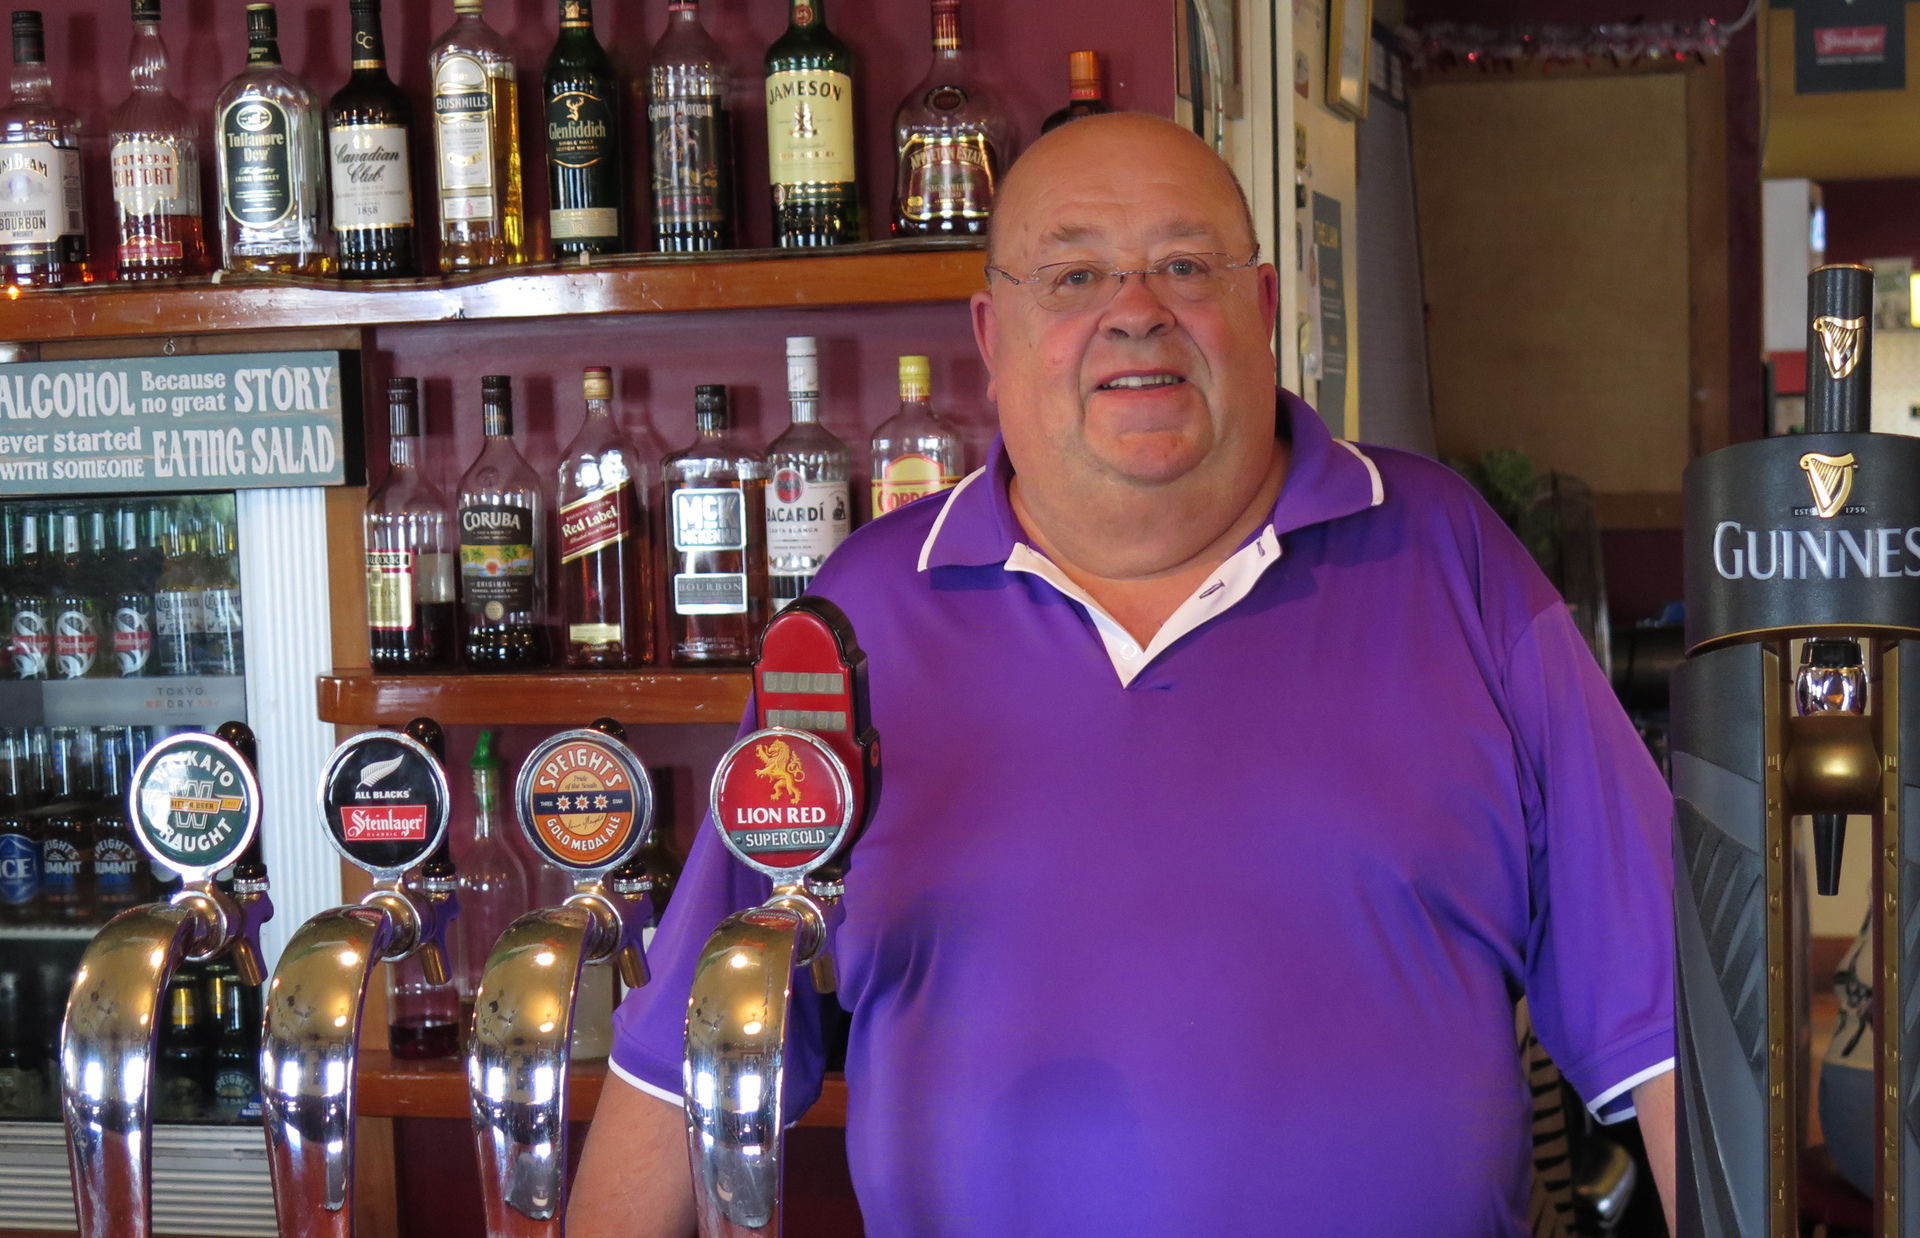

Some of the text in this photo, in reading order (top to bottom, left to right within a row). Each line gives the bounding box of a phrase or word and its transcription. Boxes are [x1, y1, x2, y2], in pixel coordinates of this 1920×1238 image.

[768, 79, 842, 105] JAMESON
[436, 96, 488, 110] BUSHMILLS
[647, 100, 714, 122] Captain Morgan
[549, 120, 606, 140] Glenfiddich
[226, 132, 284, 149] Tullamore
[243, 147, 268, 163] Dew
[335, 144, 400, 164] Canadian
[347, 164, 385, 183] Club
[357, 206, 378, 216] 1858
[0, 216, 46, 230] BOURBON
[141, 370, 226, 391] Because
[234, 366, 332, 413] STORY
[0, 371, 136, 420] ALCOHOL
[141, 392, 226, 417] no great
[0, 426, 142, 454] ever started
[152, 425, 335, 478] EATING SALAD
[0, 458, 145, 480] WITH SOMEONE
[767, 502, 825, 522] BACARDÍ
[1845, 506, 1866, 514] 1759
[462, 510, 520, 531] CORUBA
[561, 505, 617, 538] Red Label
[1713, 520, 1920, 580] GUINNES
[679, 582, 741, 591] BOURBON
[157, 687, 203, 696] TOKYO
[166, 699, 193, 708] DRY
[539, 748, 623, 789] SPEIGHT'S
[354, 790, 410, 799] ALL BLACKS
[196, 802, 214, 810] BEER
[736, 807, 826, 824] LION RED
[150, 815, 232, 852] RAUGHT
[347, 809, 423, 838] Steinlager
[546, 815, 621, 850] GOLD MEDAL ALE
[745, 829, 825, 847] SUPER COLD
[0, 858, 32, 879] CE
